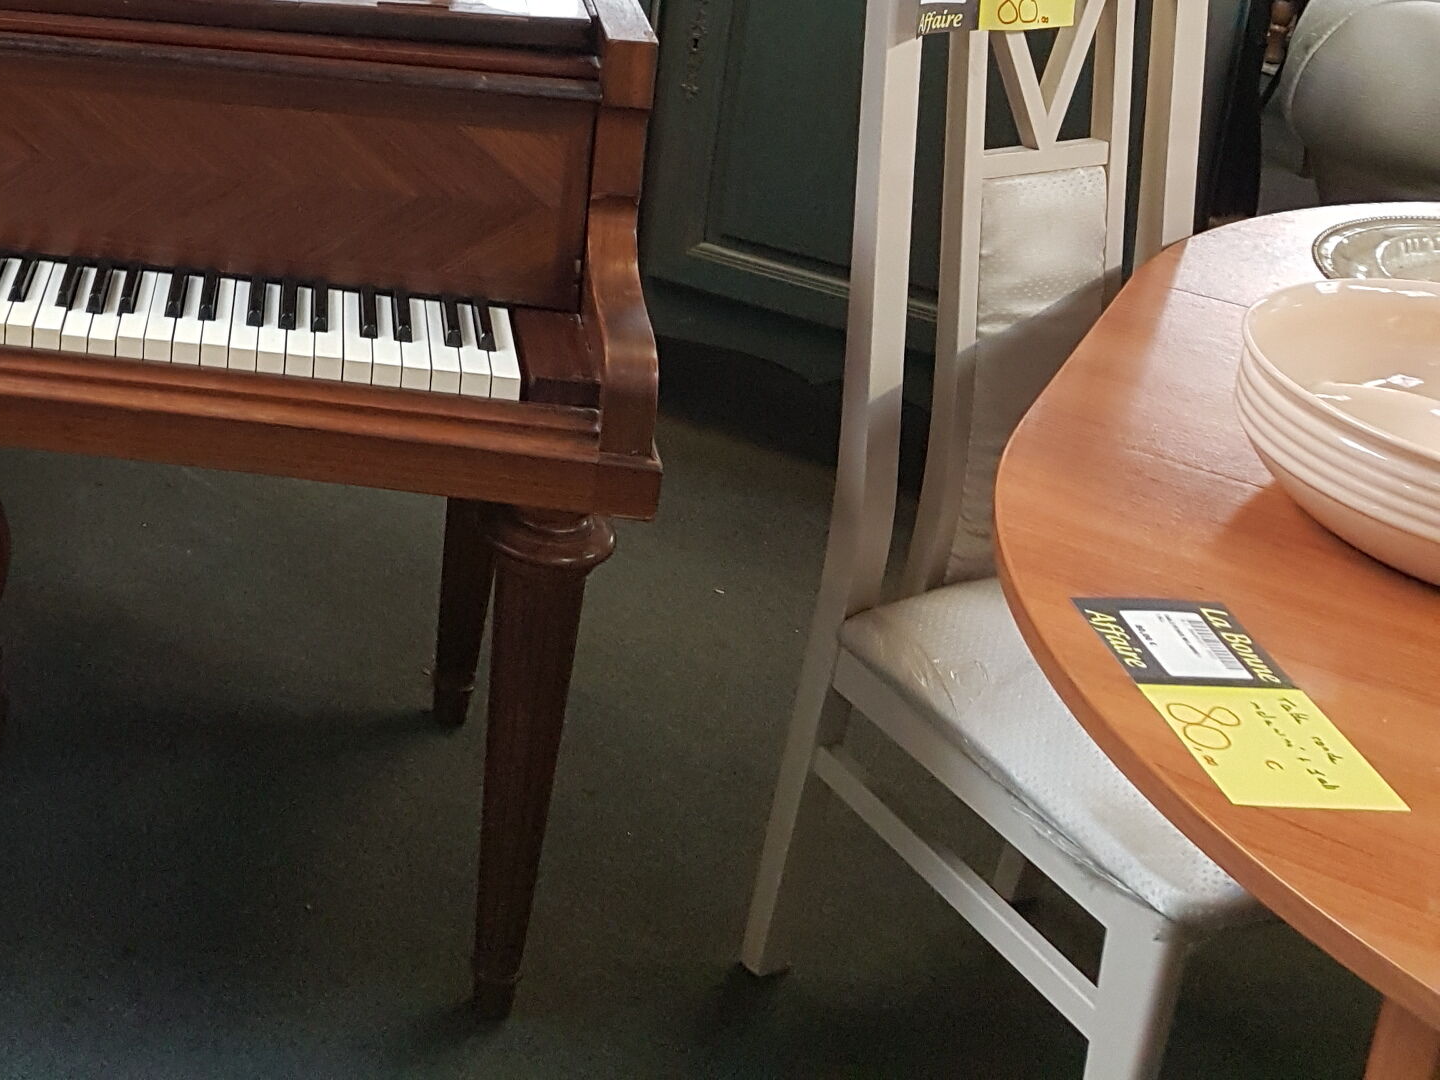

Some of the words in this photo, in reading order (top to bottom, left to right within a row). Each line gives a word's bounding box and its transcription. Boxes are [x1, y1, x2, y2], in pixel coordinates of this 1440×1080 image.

[919, 8, 964, 35] Affaire
[1083, 608, 1148, 669] Affaire
[1199, 607, 1233, 630] La
[1220, 632, 1282, 684] Bonne
